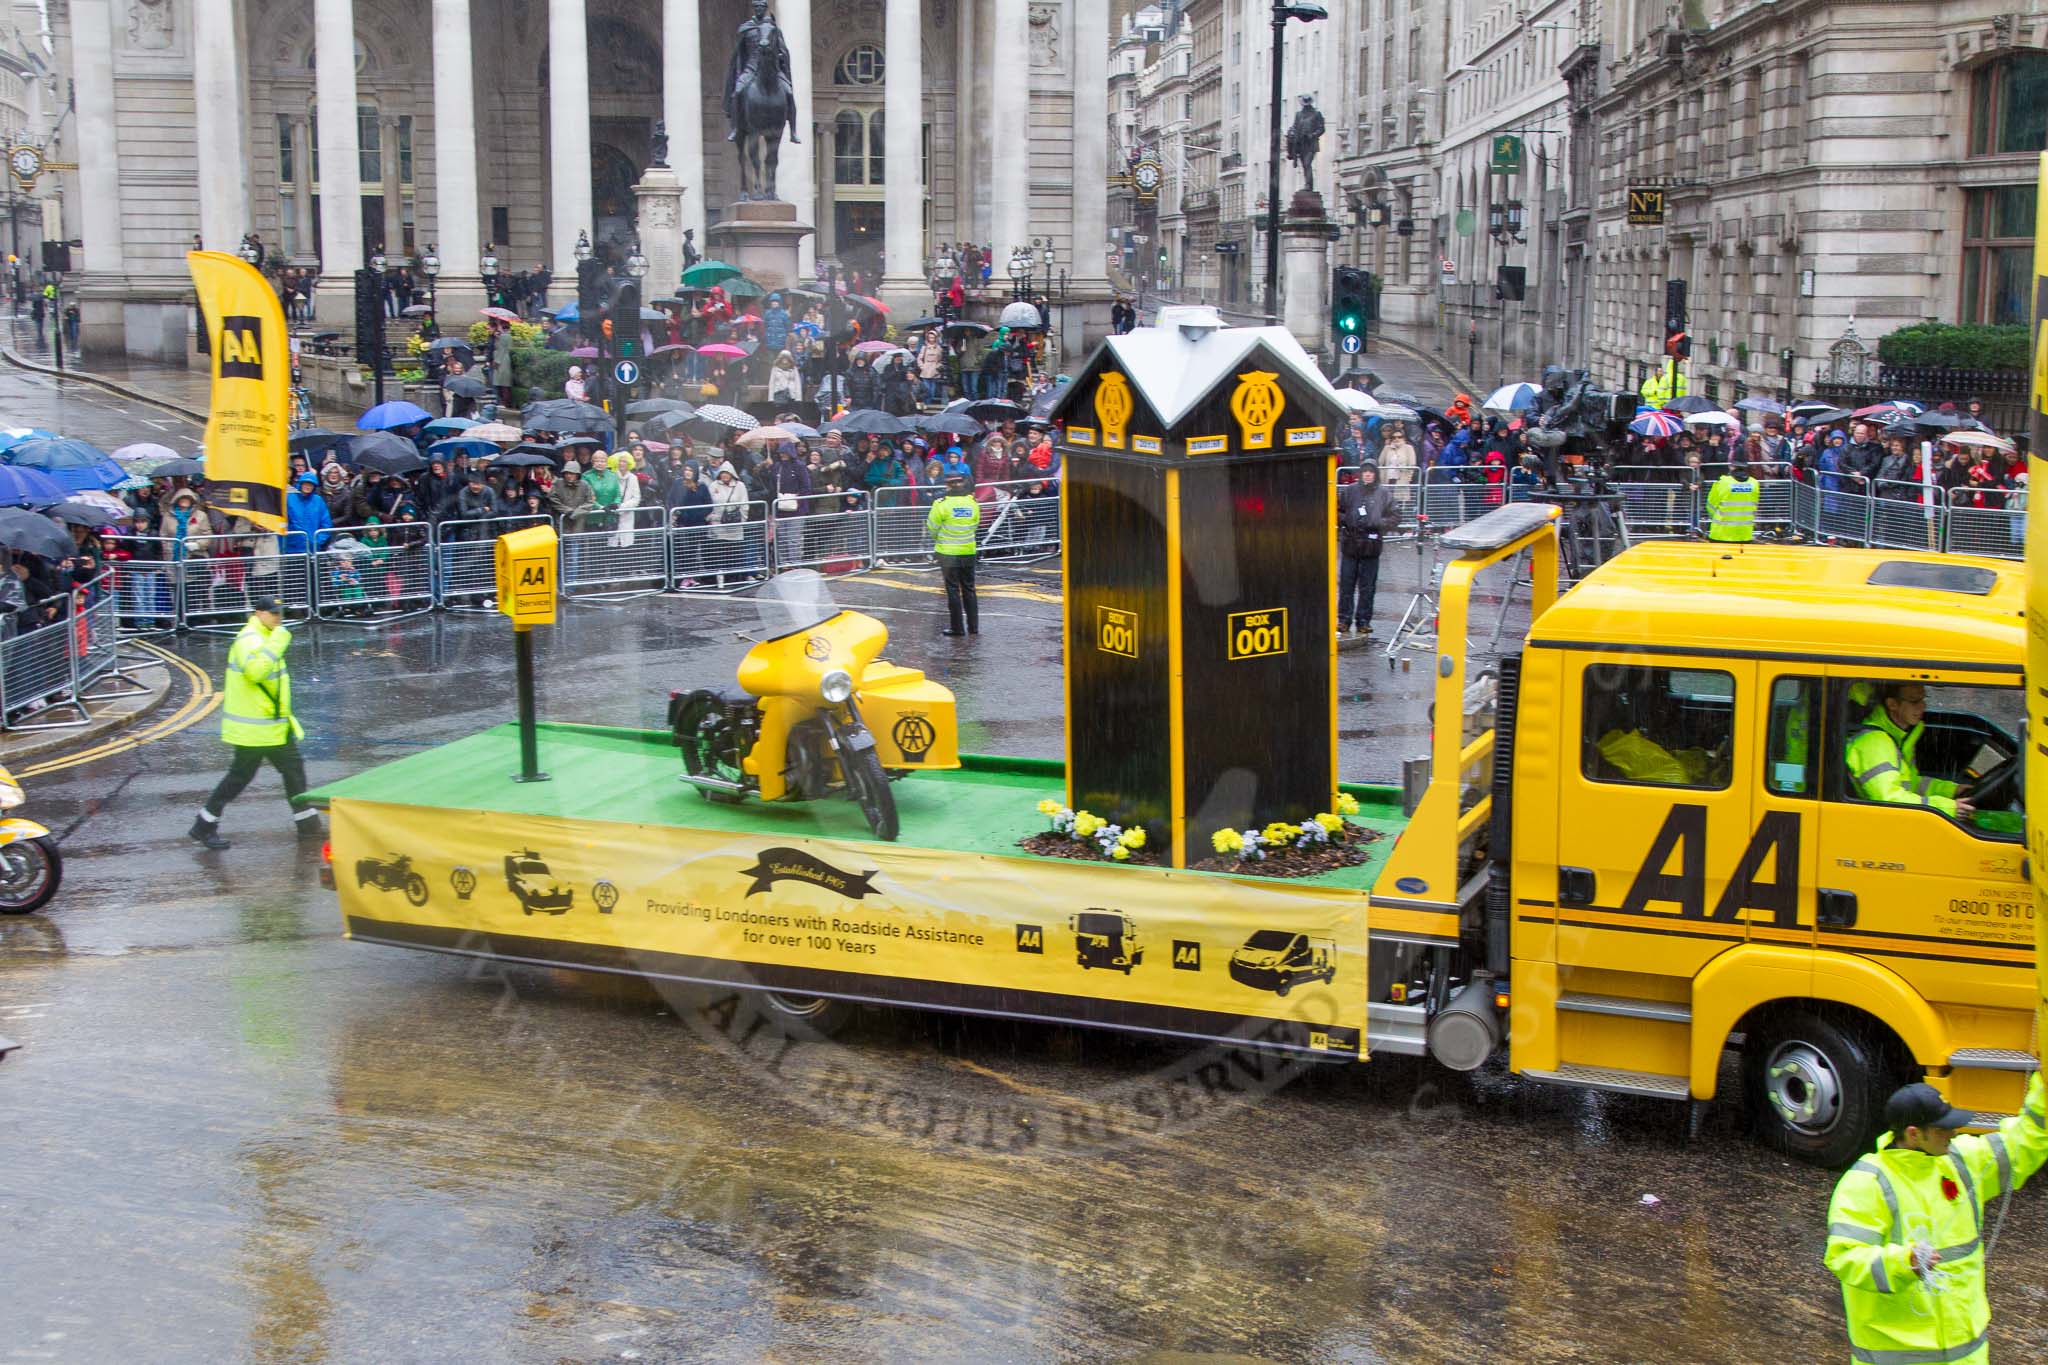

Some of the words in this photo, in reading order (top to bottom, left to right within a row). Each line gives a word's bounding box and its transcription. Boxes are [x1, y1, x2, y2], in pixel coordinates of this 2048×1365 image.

[519, 567, 545, 586] AA
[1108, 612, 1126, 624] BOX
[1245, 614, 1271, 627] BOX
[1102, 624, 1132, 653] 001
[1236, 626, 1280, 655] 001
[1621, 803, 1801, 928] AA
[1836, 858, 1859, 869] TGL
[1949, 899, 1990, 916] 0800
[1997, 902, 2019, 918] 181
[647, 899, 711, 921] Providing
[715, 907, 790, 928] Londoners
[793, 917, 827, 931] with
[832, 918, 901, 938] Roadside
[904, 925, 985, 946] Assistance
[743, 928, 765, 943] for
[769, 934, 802, 946] over
[806, 936, 832, 950] 100
[836, 938, 877, 955] Years
[1019, 931, 1041, 948] AA
[1176, 947, 1197, 965] AA
